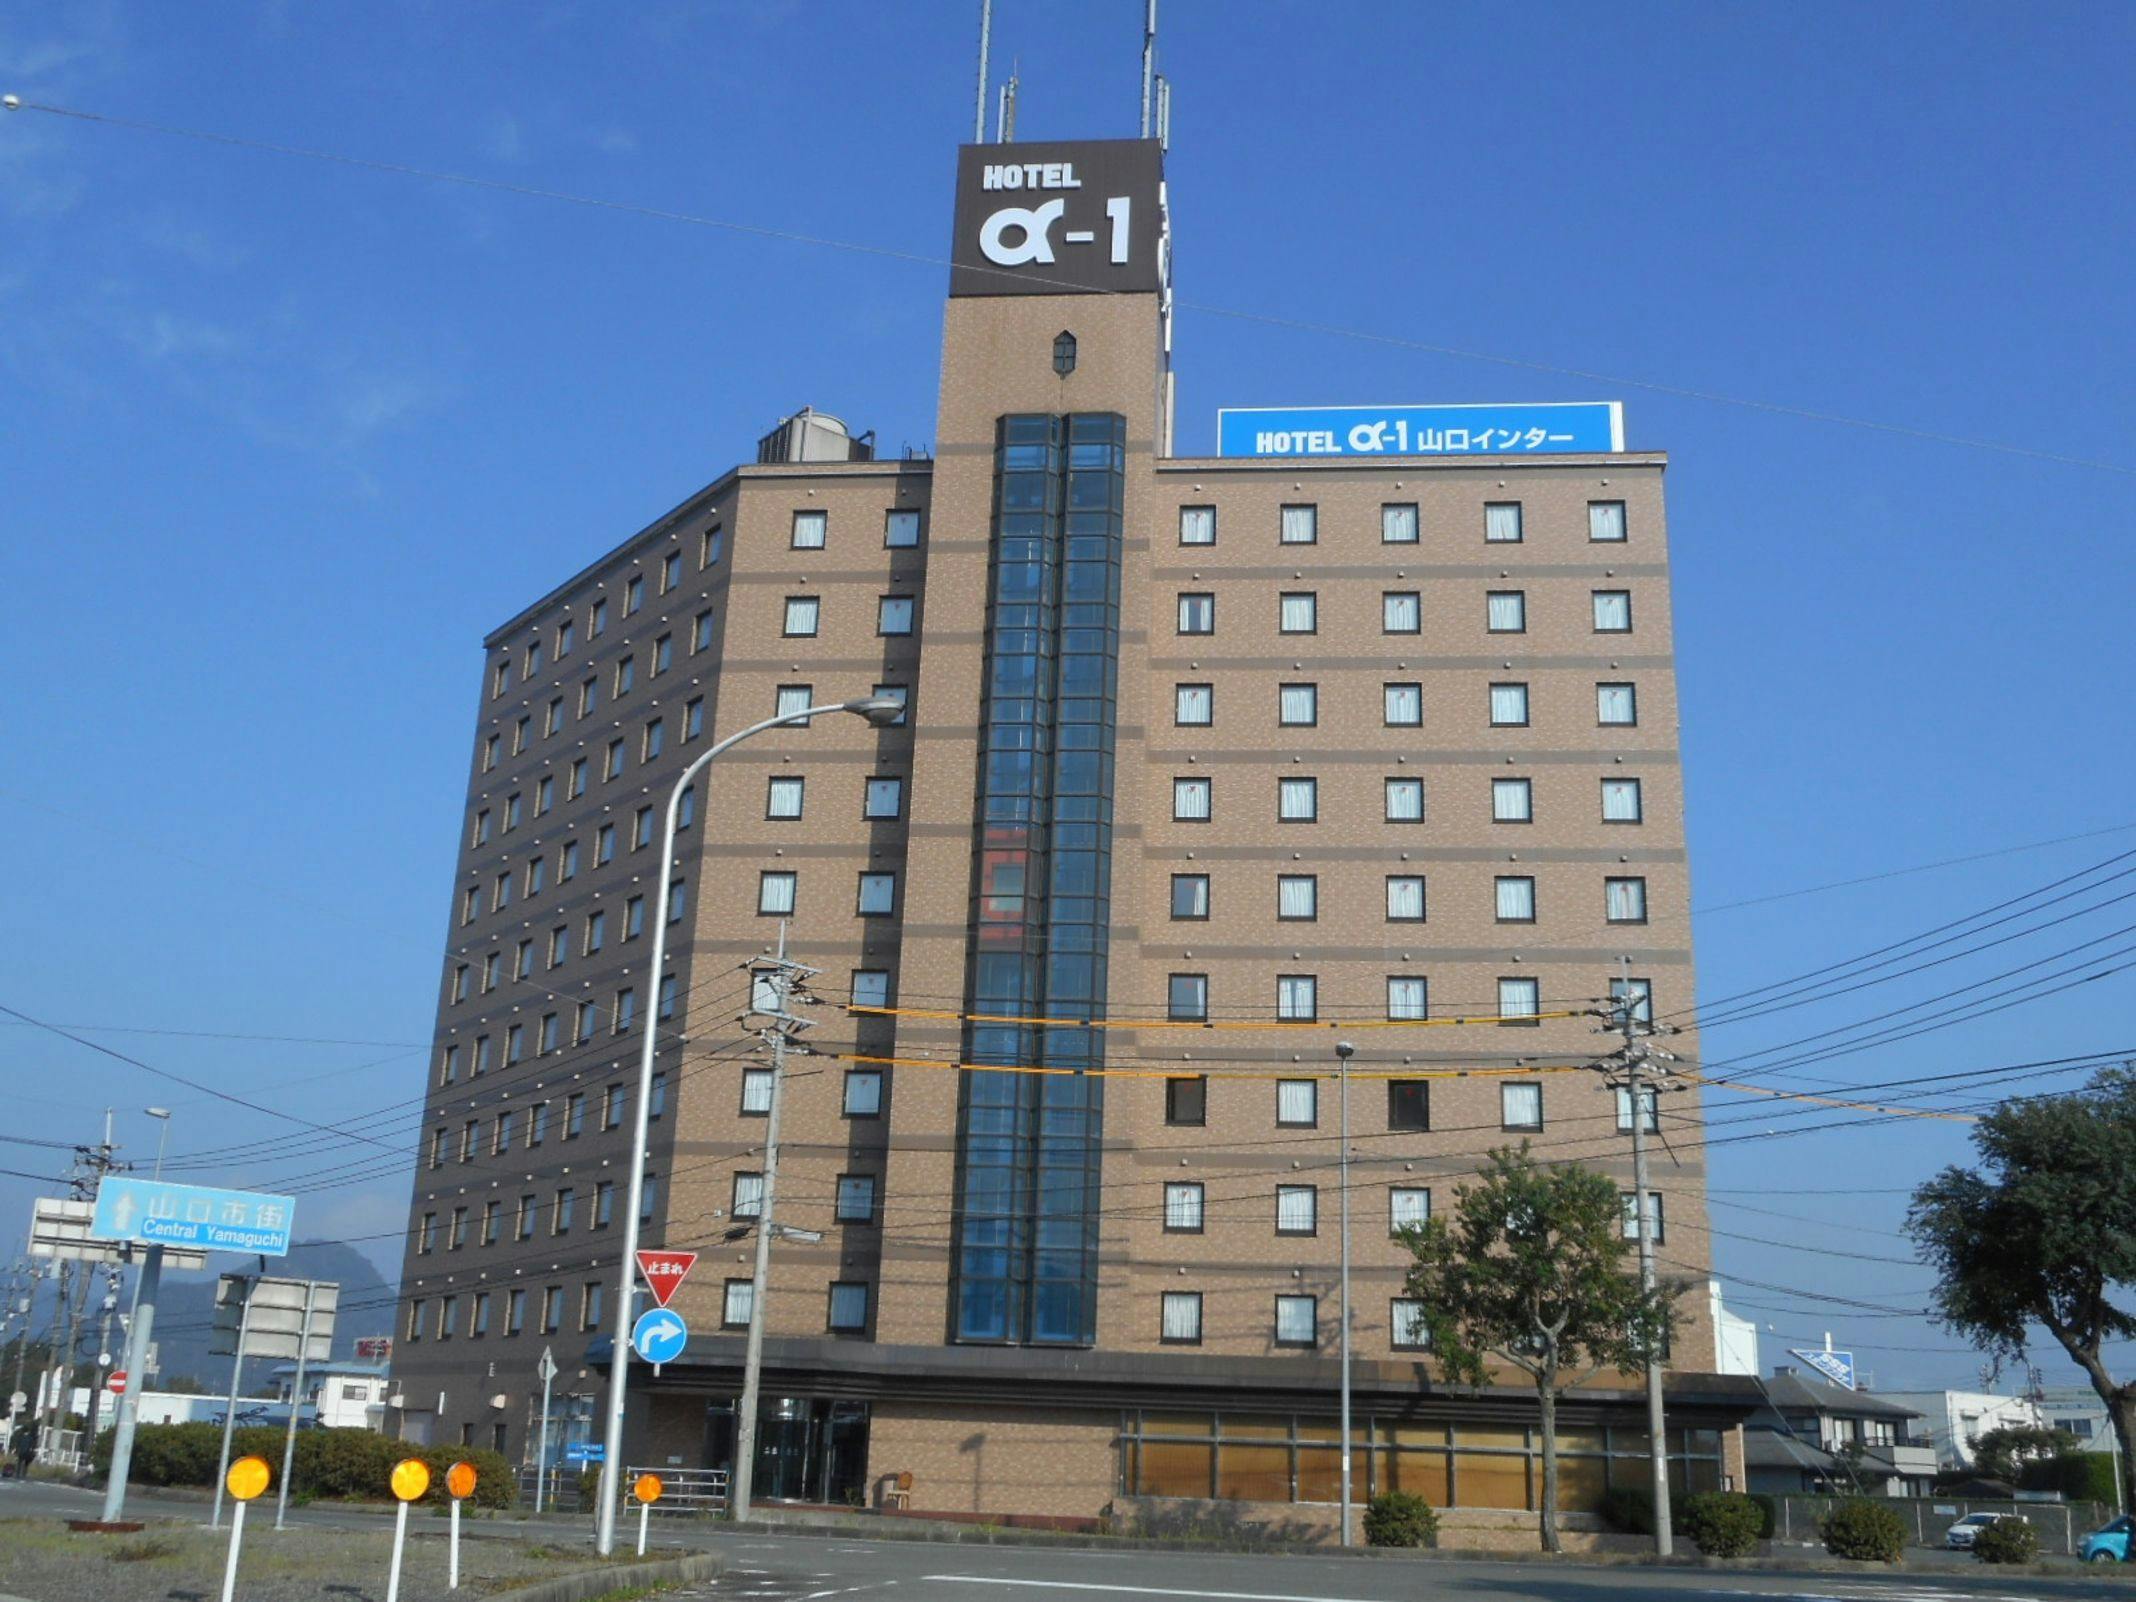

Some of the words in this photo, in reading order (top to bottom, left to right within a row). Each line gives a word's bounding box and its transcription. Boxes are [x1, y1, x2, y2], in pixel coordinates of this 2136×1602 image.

[983, 163, 1082, 190] HOTEL
[1256, 431, 1342, 453] HOTEL
[1418, 427, 1574, 451] 山口インター
[148, 1194, 285, 1229] 山口市街
[143, 1219, 198, 1239] Central
[206, 1225, 284, 1248] Yamaguchi
[647, 1261, 683, 1275] 止まれ
